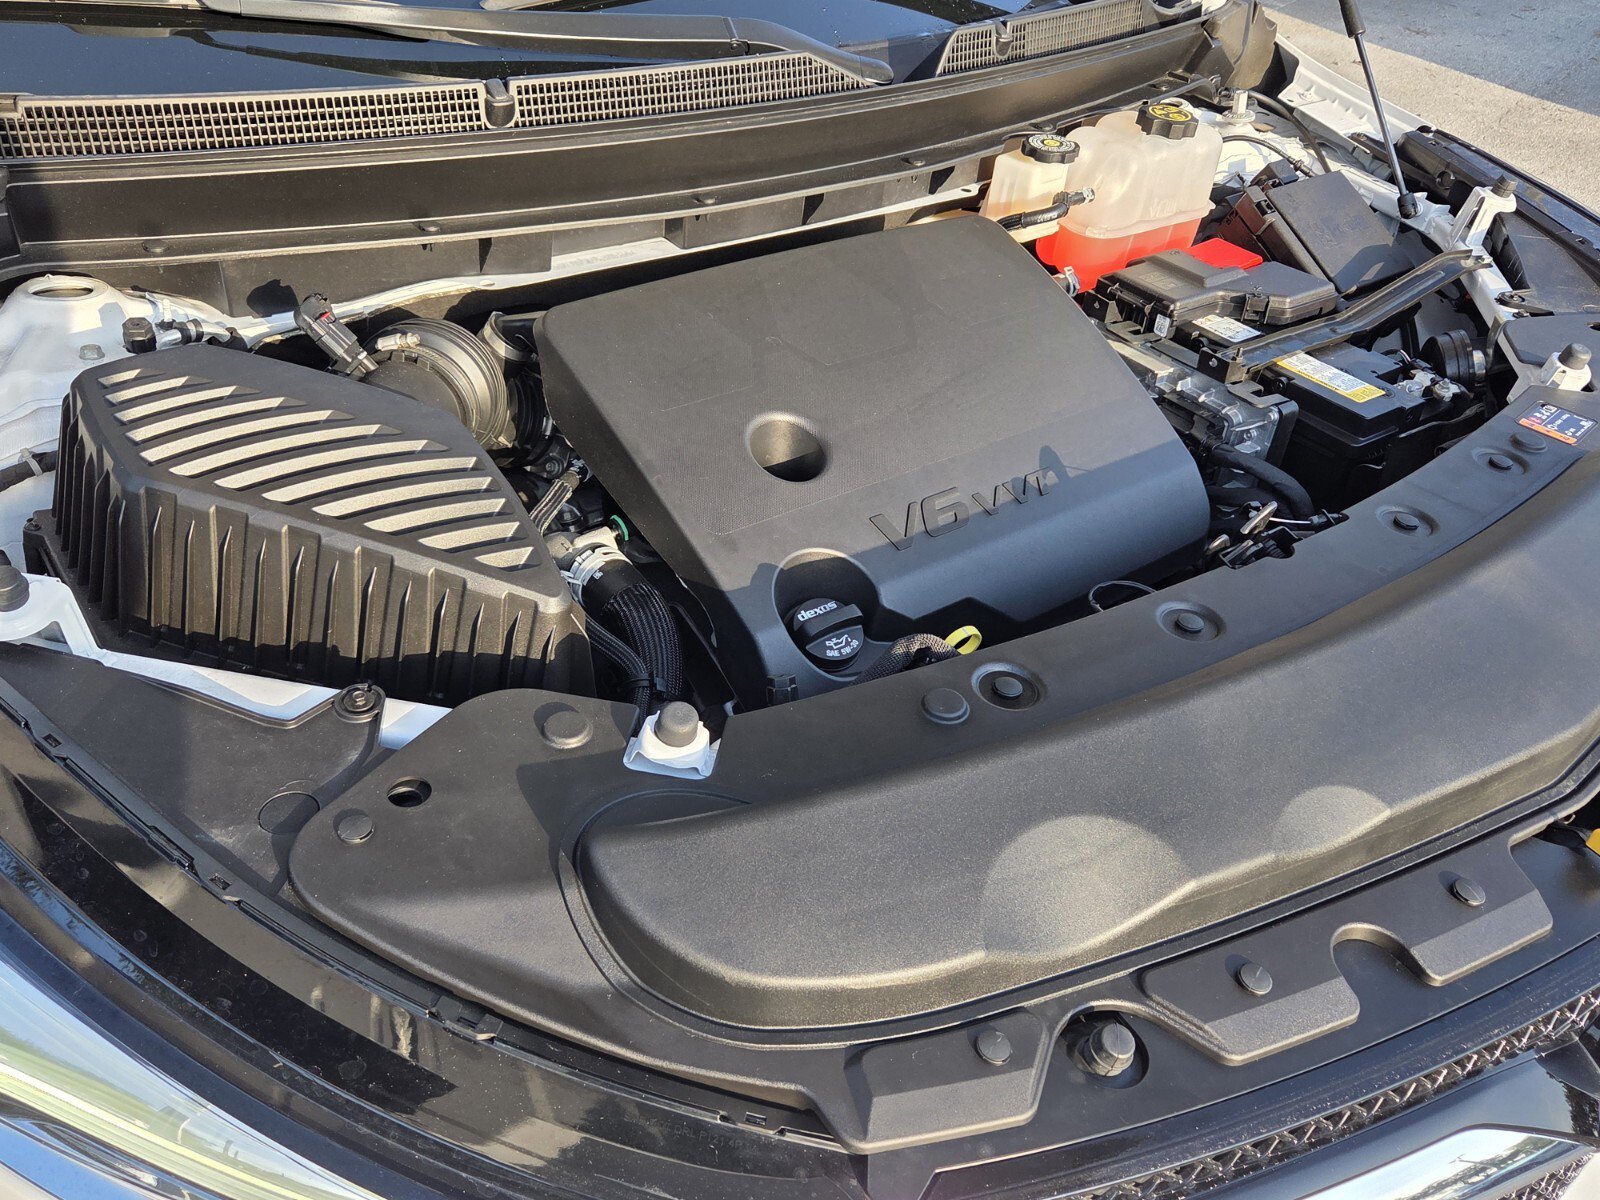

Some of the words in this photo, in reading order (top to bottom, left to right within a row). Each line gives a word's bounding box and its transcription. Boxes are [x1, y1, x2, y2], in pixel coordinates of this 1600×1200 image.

[869, 486, 970, 551] V6
[797, 600, 838, 622] dexos
[826, 649, 841, 657] SAE
[840, 639, 859, 655] 5W-30
